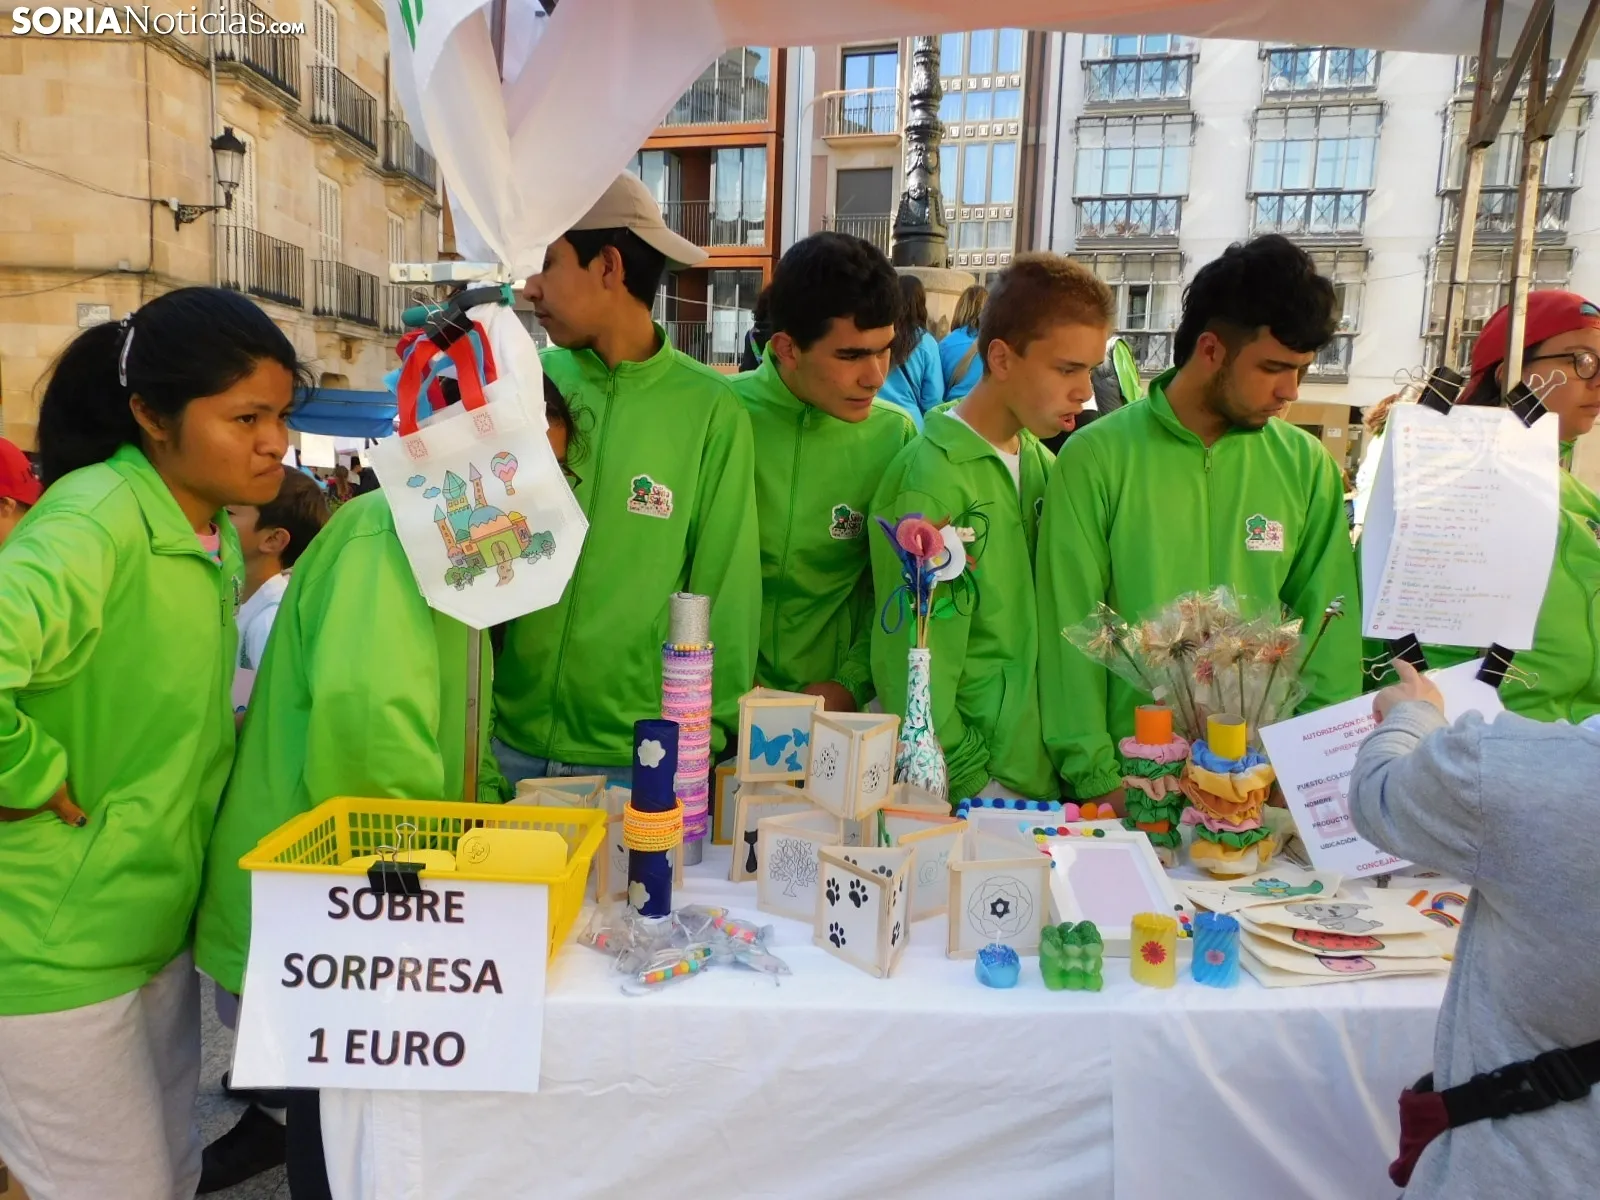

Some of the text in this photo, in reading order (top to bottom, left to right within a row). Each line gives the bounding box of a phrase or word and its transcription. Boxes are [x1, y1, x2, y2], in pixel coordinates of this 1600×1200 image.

[1302, 720, 1355, 741] AUTORIZACIÓN
[1343, 731, 1354, 739] DE
[327, 885, 465, 924] SOBRE
[280, 953, 503, 995] SORPRESA
[307, 1028, 466, 1067] 1 EURO
